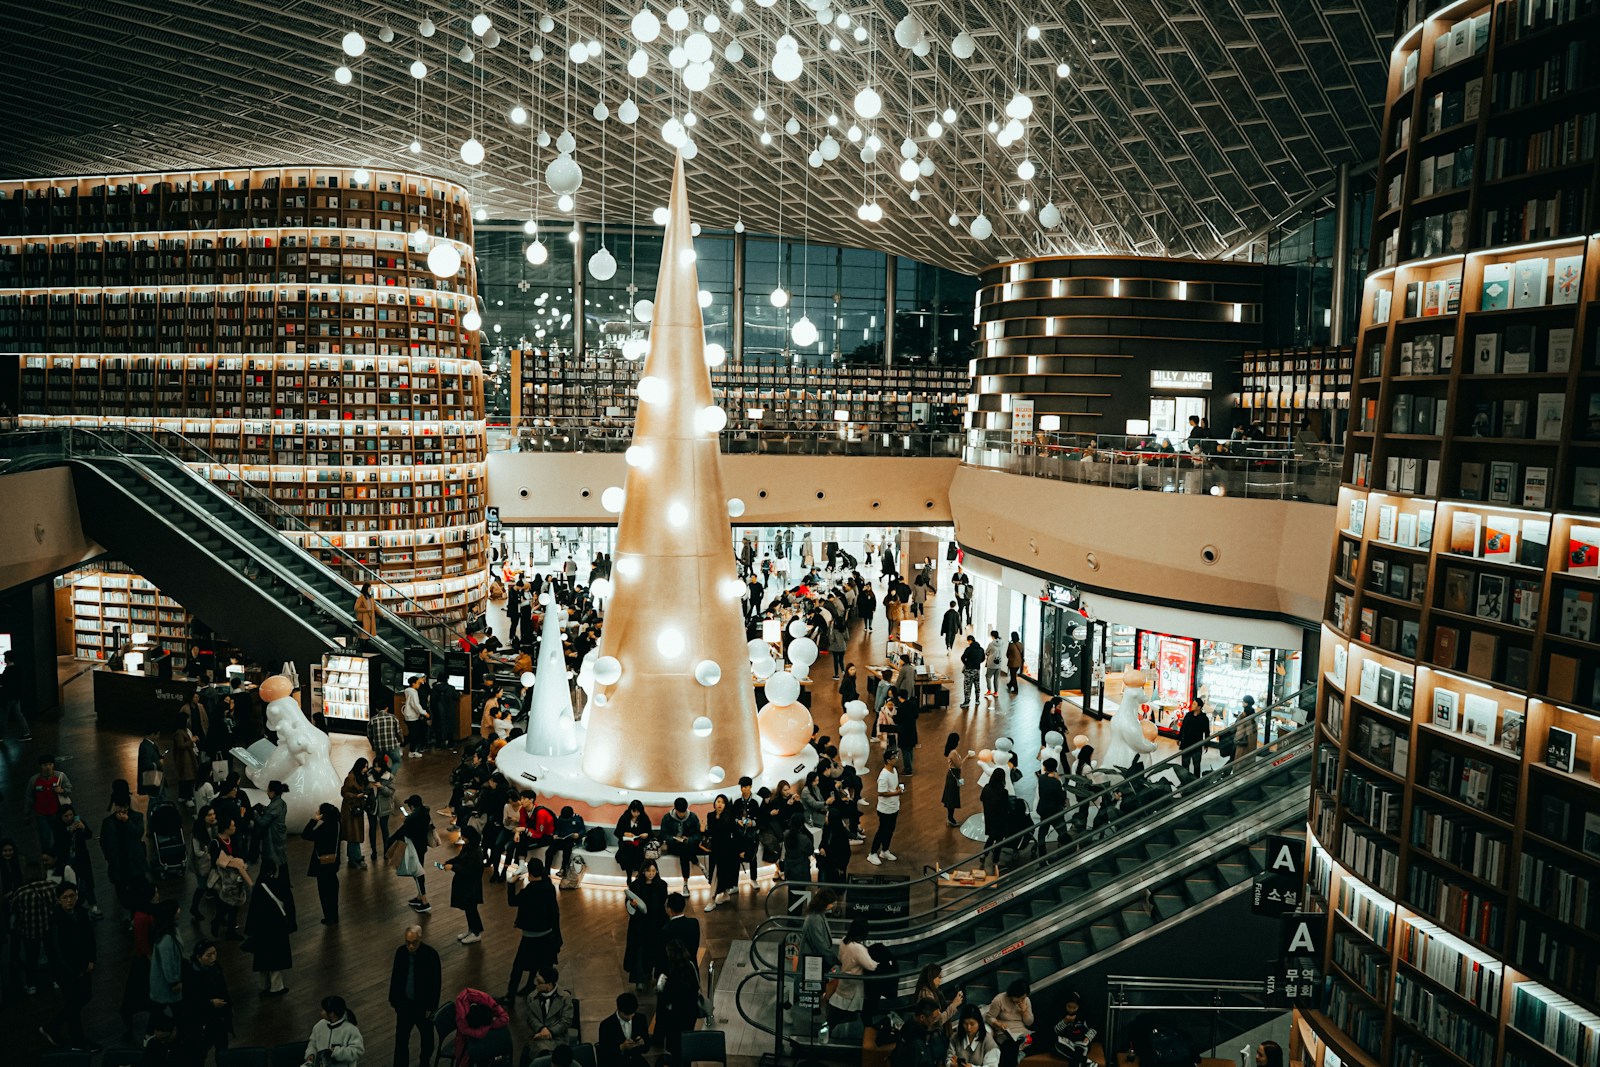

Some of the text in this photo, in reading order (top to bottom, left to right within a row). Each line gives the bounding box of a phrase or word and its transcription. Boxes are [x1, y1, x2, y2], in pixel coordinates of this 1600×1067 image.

[1154, 371, 1212, 382] BILLY ANGEL
[1272, 845, 1296, 873] A
[1254, 882, 1262, 906] Fiction
[1267, 888, 1297, 906] 소설
[1288, 922, 1315, 952] A
[1267, 975, 1275, 995] KITA
[1285, 969, 1314, 982] 무역
[1285, 985, 1313, 998] 협회
